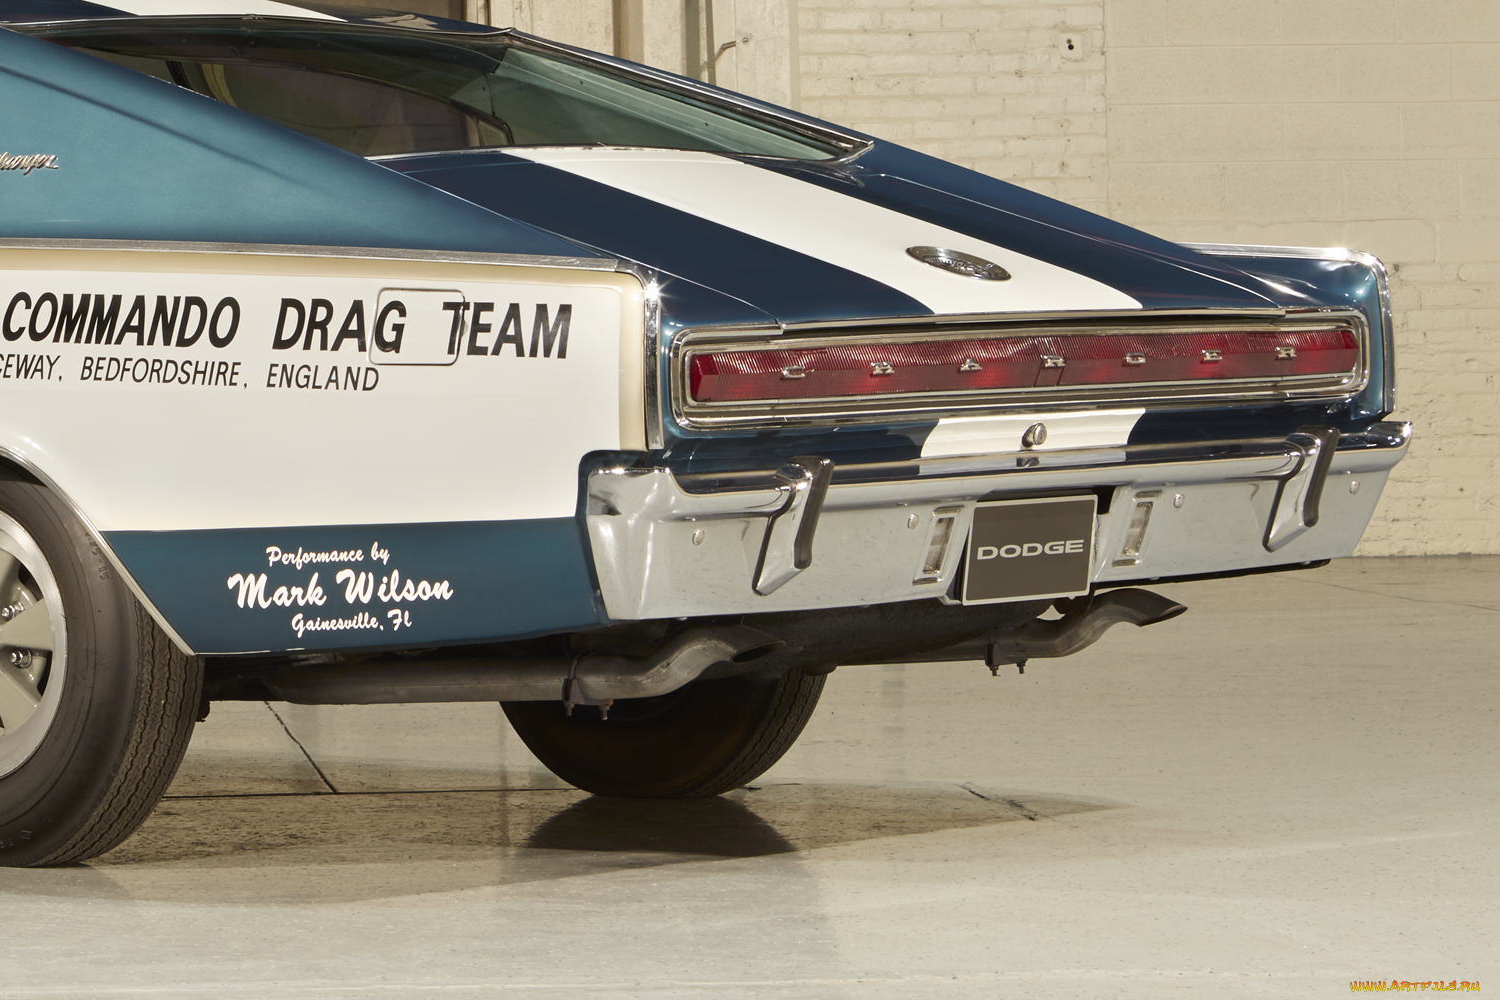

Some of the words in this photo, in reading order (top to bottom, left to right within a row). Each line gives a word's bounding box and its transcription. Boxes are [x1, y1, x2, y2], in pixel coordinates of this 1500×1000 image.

[1, 291, 241, 349] COMMANDO
[271, 297, 407, 354] DRAG
[442, 301, 573, 359] TEAM
[80, 356, 249, 390] BEDFORDSHIRE,
[266, 363, 380, 392] ENGLAND
[265, 545, 364, 570] Performance
[370, 541, 391, 565] by
[977, 539, 1084, 560] DODGE
[226, 571, 327, 609] Mark
[335, 568, 454, 604] Wilson
[291, 612, 384, 639] Gainesville,
[386, 608, 412, 632] Fl
